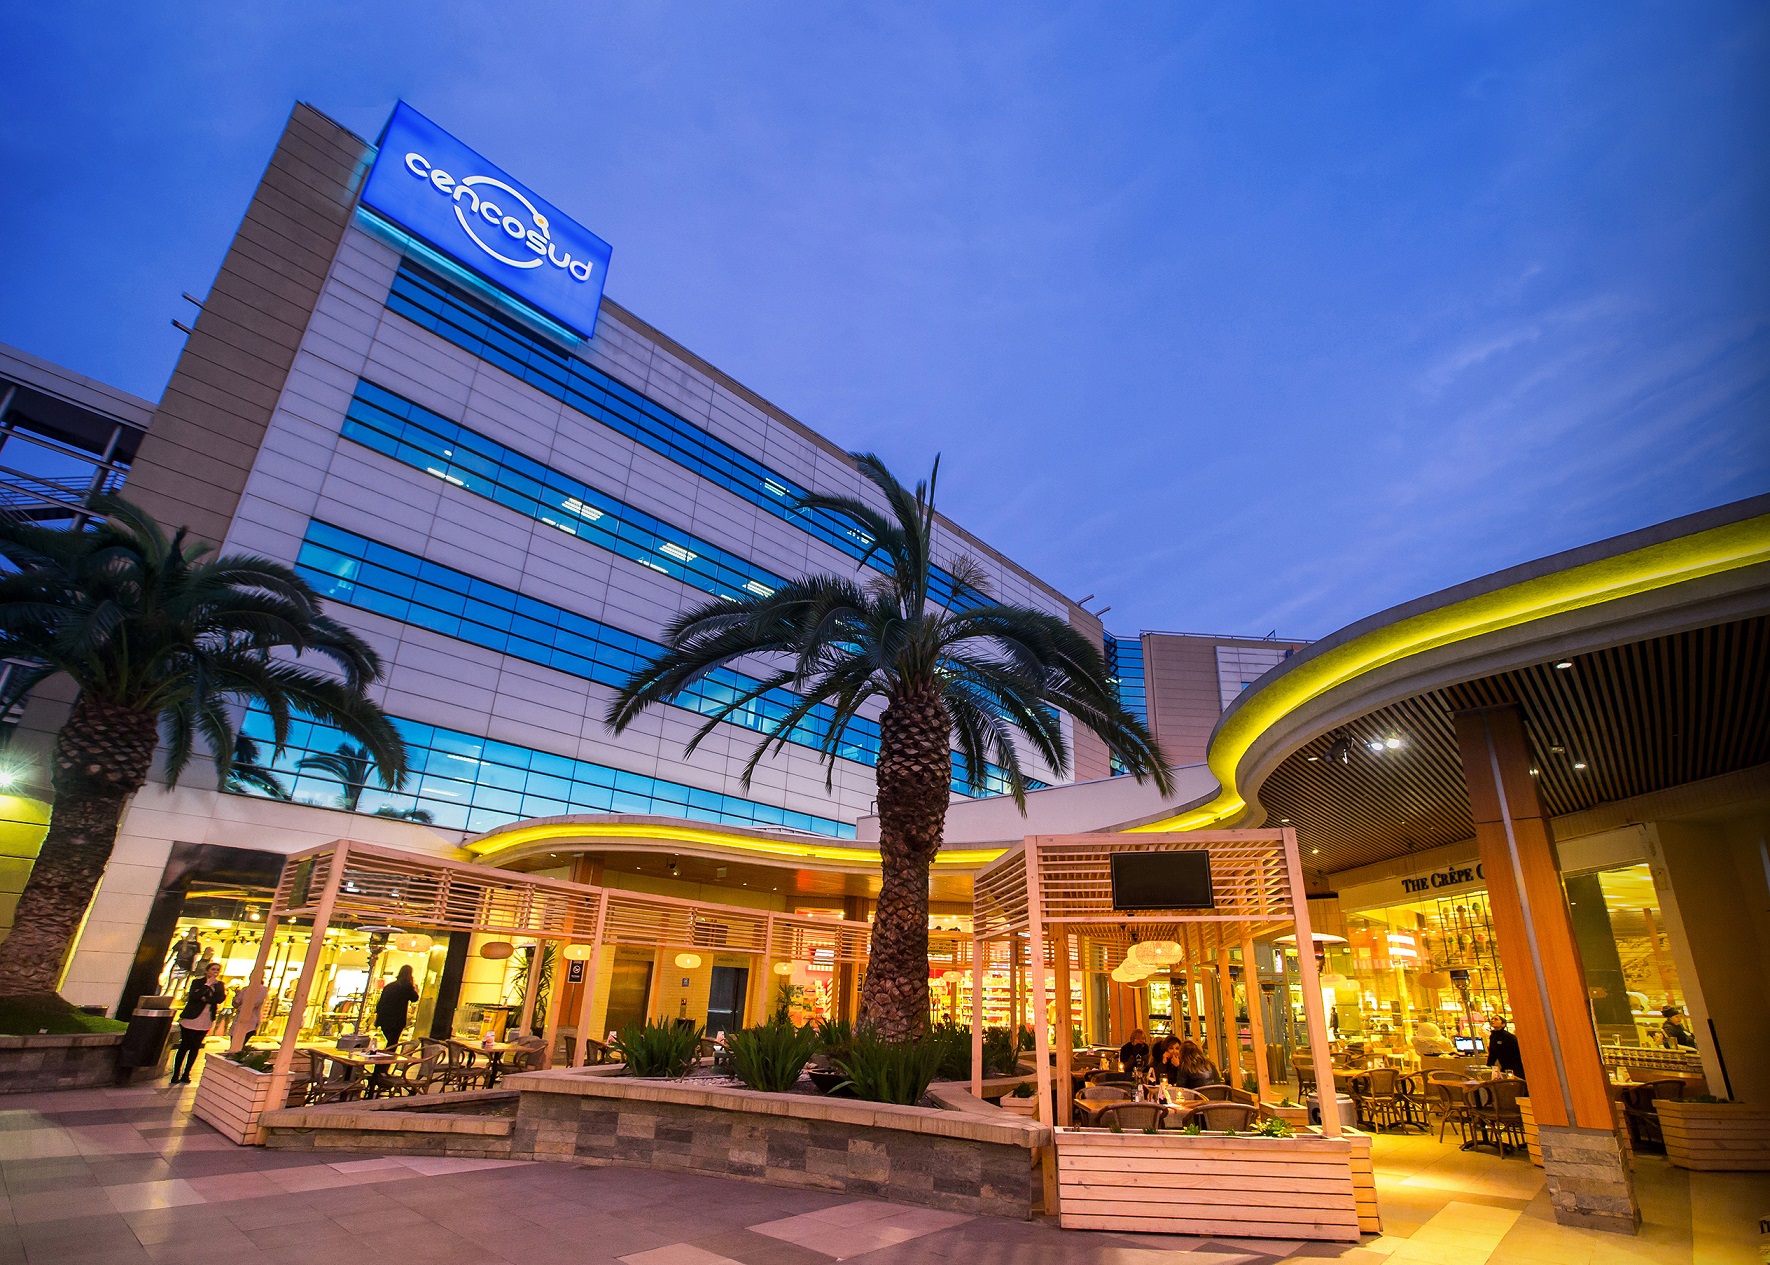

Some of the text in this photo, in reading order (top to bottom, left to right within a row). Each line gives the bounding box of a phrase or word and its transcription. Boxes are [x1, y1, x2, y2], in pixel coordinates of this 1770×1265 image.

[404, 152, 594, 282] cencosud
[1401, 878, 1429, 893] THE
[1431, 867, 1474, 888] CRÊPE
